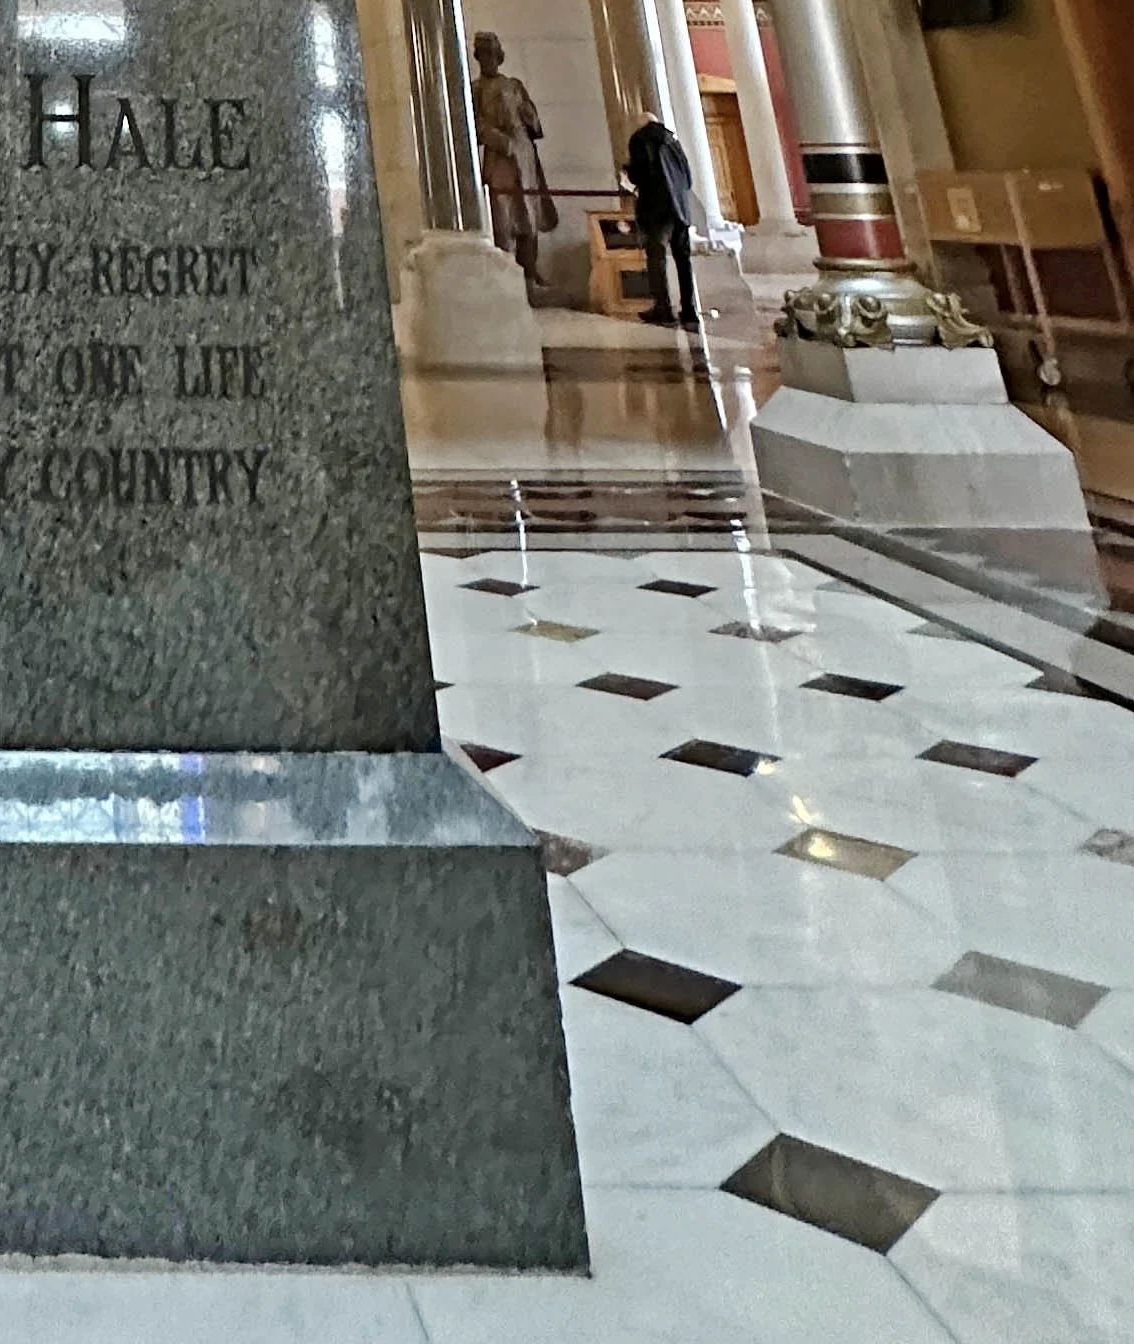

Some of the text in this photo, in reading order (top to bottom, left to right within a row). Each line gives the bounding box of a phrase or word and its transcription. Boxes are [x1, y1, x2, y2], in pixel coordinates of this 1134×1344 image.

[20, 72, 251, 171] HALE
[90, 245, 260, 298] REGRET
[56, 340, 143, 397] ONE
[175, 344, 268, 400] LIFE
[32, 446, 269, 507] COUNTRY
